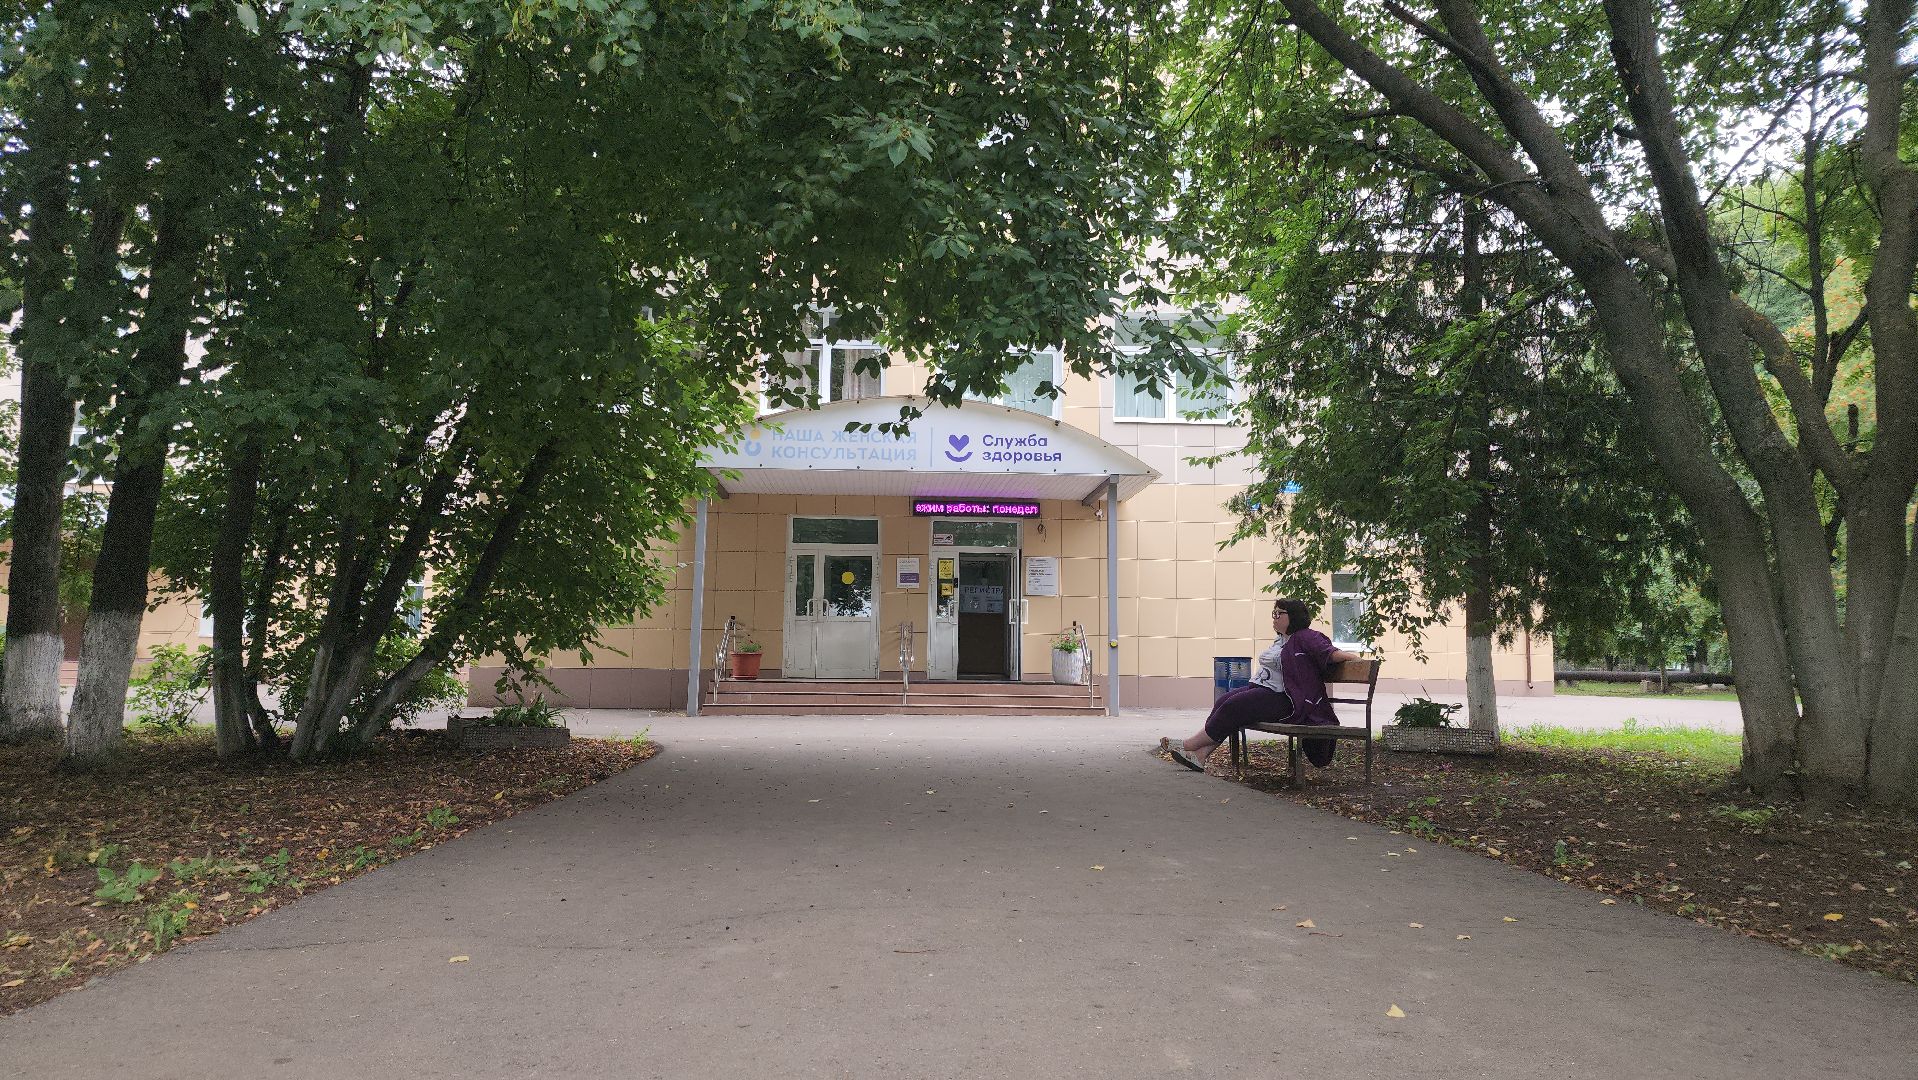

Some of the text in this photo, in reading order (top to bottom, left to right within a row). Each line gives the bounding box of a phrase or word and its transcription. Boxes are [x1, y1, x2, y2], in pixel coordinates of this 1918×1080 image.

[772, 429, 824, 442] НАША
[982, 434, 1048, 449] Служба
[771, 445, 917, 462] КОНСУЛЬТАЦИЯ
[982, 451, 1062, 464] здоровья
[915, 503, 1038, 515] ежим работы: понедел
